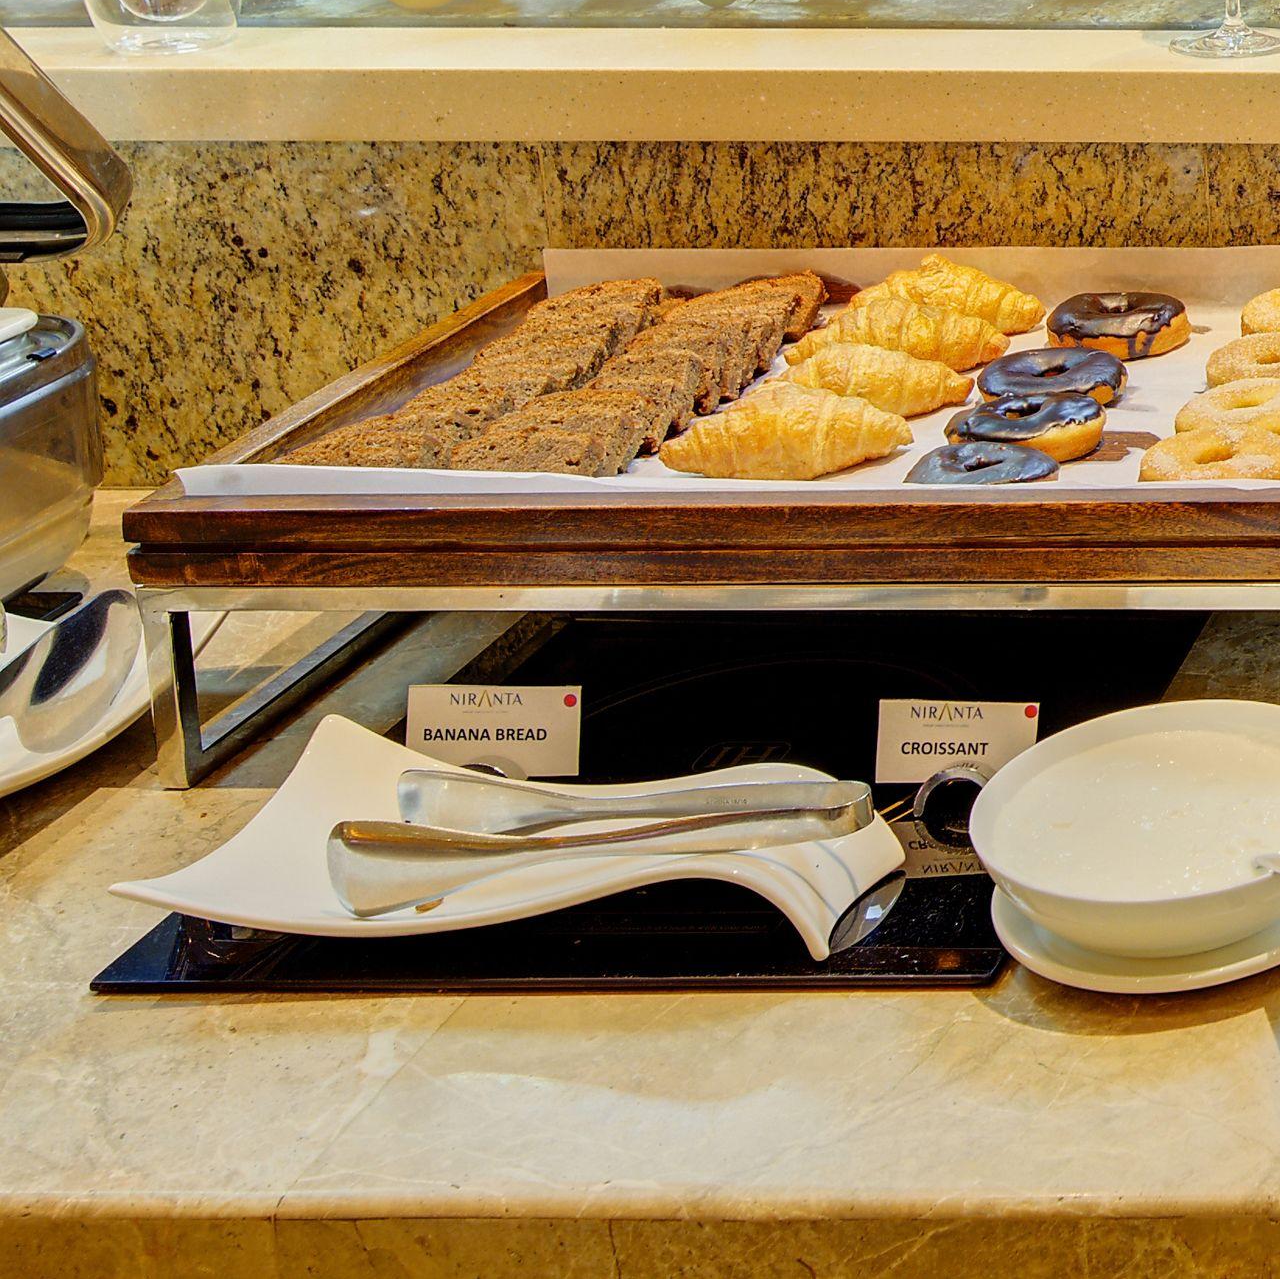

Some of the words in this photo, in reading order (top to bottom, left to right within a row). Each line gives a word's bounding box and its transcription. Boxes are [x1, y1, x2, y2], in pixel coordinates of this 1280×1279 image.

[450, 689, 523, 708] NIRANTA
[910, 703, 984, 721] NIRANTA
[423, 728, 491, 741] BANANA
[495, 728, 548, 741] BREAD
[901, 742, 989, 756] CROISSANT
